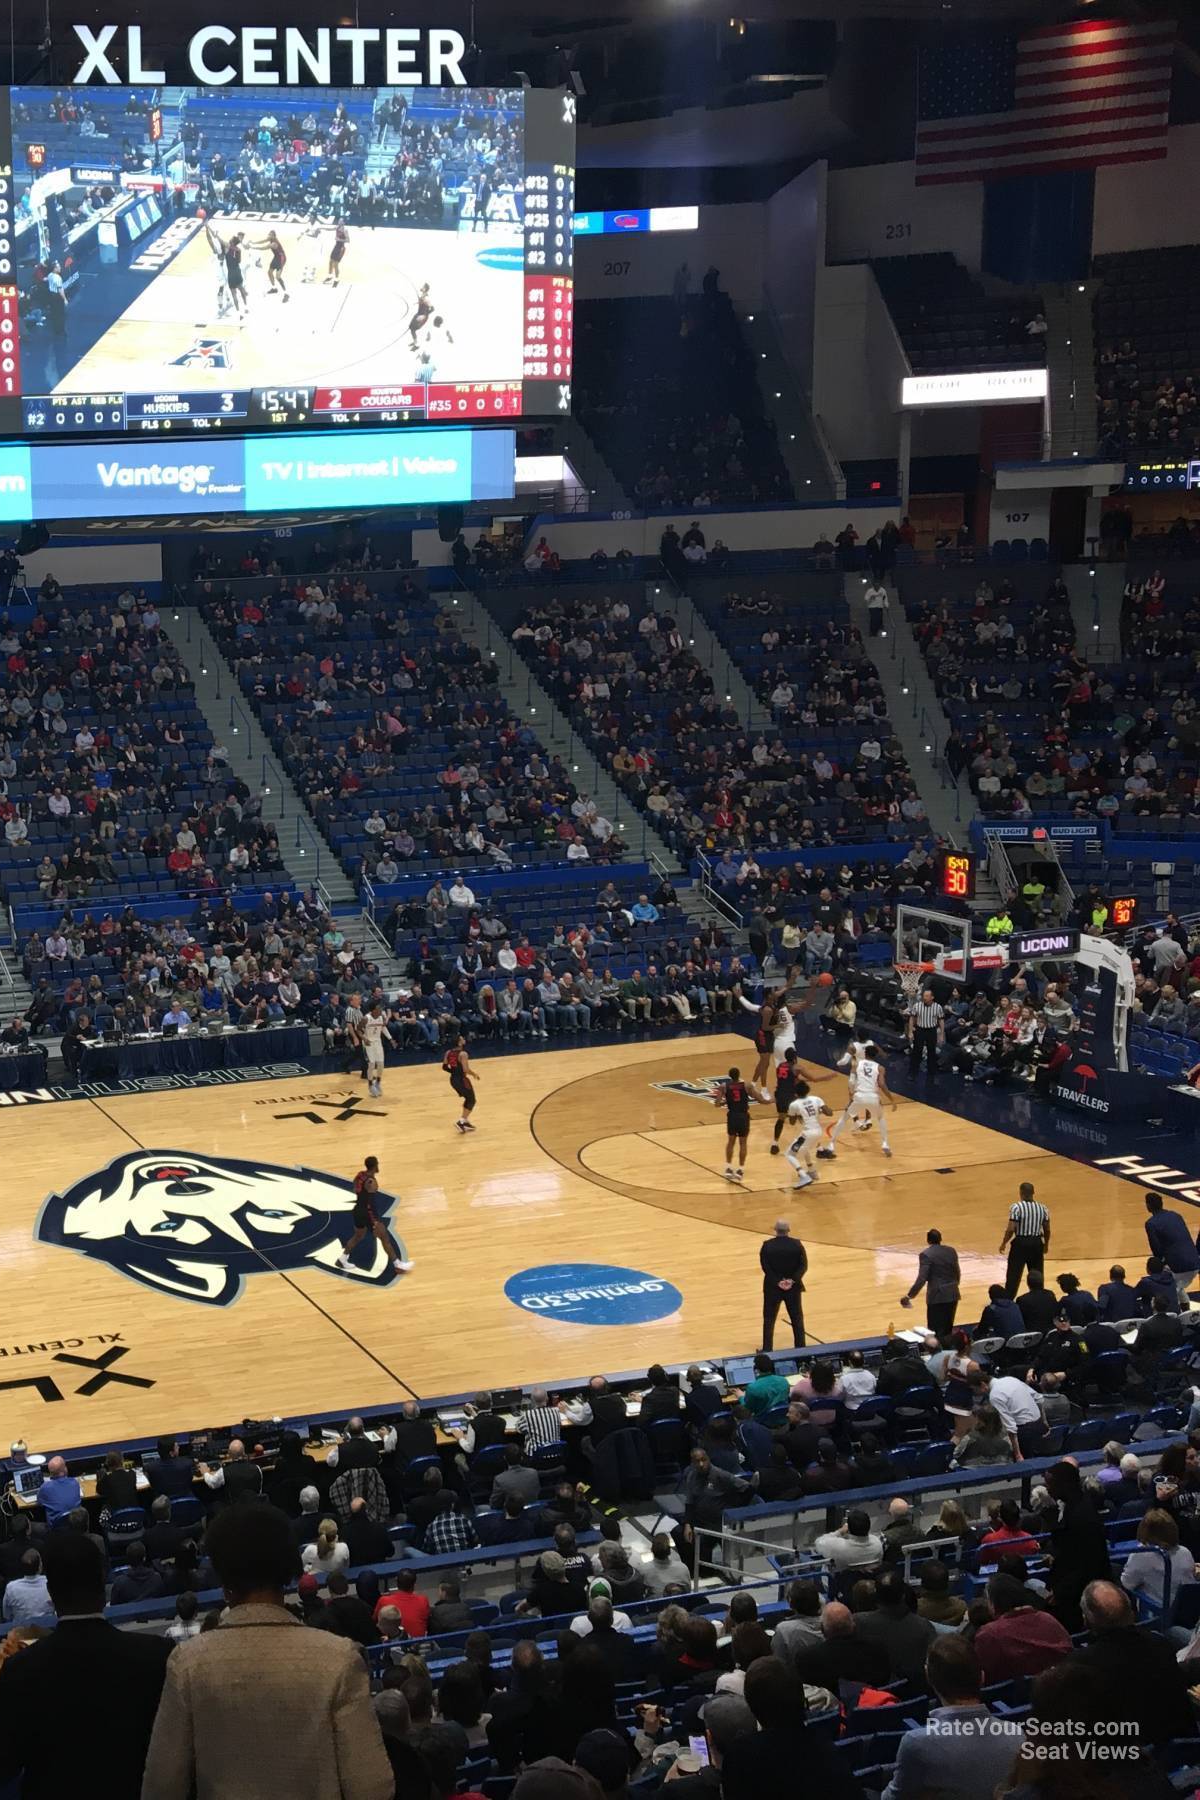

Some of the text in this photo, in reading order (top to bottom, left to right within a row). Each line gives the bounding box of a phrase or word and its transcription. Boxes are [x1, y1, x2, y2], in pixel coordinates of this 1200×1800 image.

[72, 25, 468, 85] XL CENTER
[525, 176, 564, 191] #12 0
[525, 194, 563, 209] #15 3
[524, 213, 549, 227] #25
[556, 214, 564, 228] 0
[529, 232, 564, 246] #1 0
[886, 224, 912, 240] 231
[528, 250, 545, 264] #2
[555, 252, 563, 265] 0
[604, 262, 631, 276] 207
[529, 289, 562, 303] #1 2
[527, 307, 562, 321] #3 0
[527, 326, 562, 340] #5 0
[1, 339, 14, 353] 0
[524, 344, 562, 358] #25 0
[2, 358, 14, 372] 0
[524, 362, 561, 376] #35 0
[5, 377, 13, 391] 1
[474, 384, 489, 392] AST
[52, 398, 67, 406] PTS
[71, 397, 87, 405] AST
[109, 396, 123, 404] FLS
[220, 393, 234, 412] 3
[261, 389, 309, 411] 15:47
[328, 389, 343, 408] 2
[360, 395, 412, 406] COUGARS
[429, 398, 518, 412] #35 0 0 0 1
[143, 403, 190, 414] HUSKIES
[28, 411, 121, 425] #2 0 0 0 0
[192, 418, 222, 428] TOL 4
[271, 413, 289, 423] 1ST
[331, 413, 360, 423] TOL 4
[381, 411, 409, 421] FLS 3
[142, 419, 171, 429] FLS 0
[261, 457, 458, 480] TV Internet Voice
[97, 462, 211, 493] Vantage
[1141, 474, 1185, 484] 0 0 0 0
[196, 484, 242, 496] by Frontier
[611, 511, 632, 521] 106
[1005, 512, 1030, 523] 107
[274, 528, 293, 538] 105
[1052, 827, 1097, 835] BUD LIGHT
[948, 857, 969, 870] 15:47
[948, 871, 967, 894] 30
[1114, 899, 1136, 909] 15:47
[1117, 910, 1130, 923] 30
[1021, 936, 1069, 953] UCONN
[50, 1062, 310, 1099] HUSKIES
[254, 1092, 331, 1105] CENTER
[732, 1090, 741, 1102] 3
[1057, 1085, 1110, 1113] TRAVELERS
[273, 1097, 388, 1123] XL
[521, 1279, 667, 1310] genius3D
[88, 1332, 126, 1344] XL
